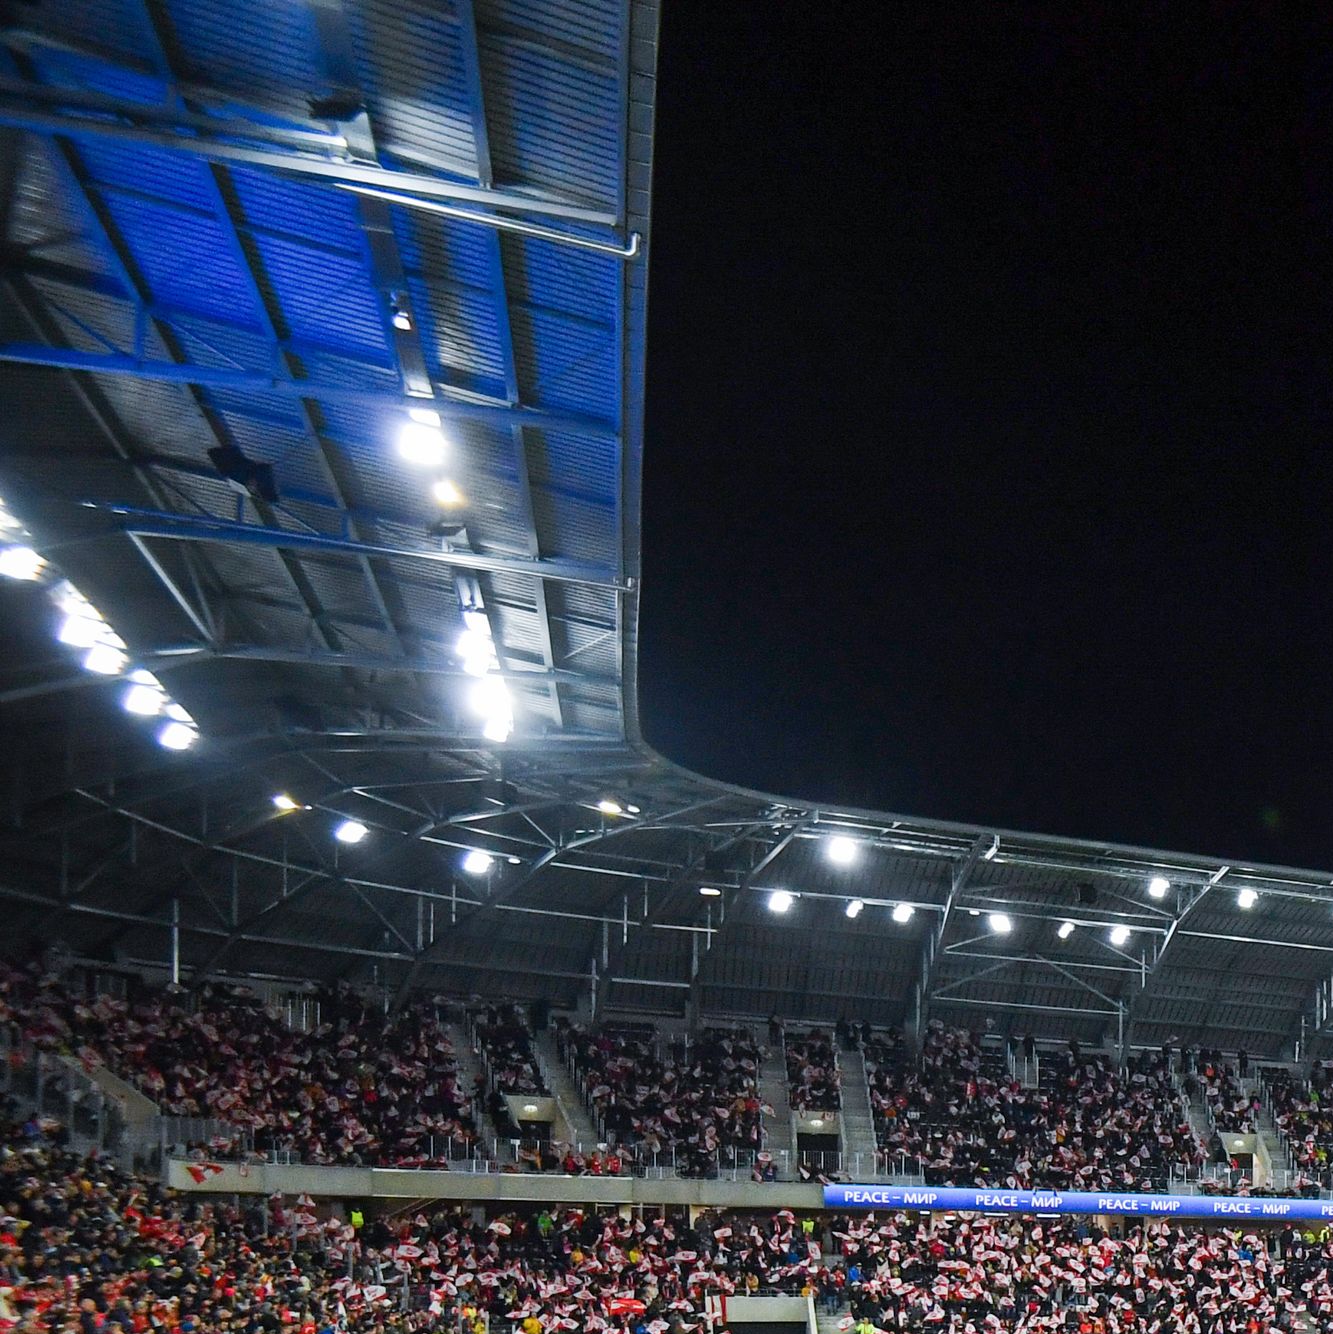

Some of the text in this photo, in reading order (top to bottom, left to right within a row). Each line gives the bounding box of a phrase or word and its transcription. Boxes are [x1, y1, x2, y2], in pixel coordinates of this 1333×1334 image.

[844, 1191, 889, 1203] PEACE
[904, 1192, 937, 1204] МИР
[975, 1195, 1018, 1207] PEACE
[1032, 1197, 1062, 1208] МИР
[1099, 1199, 1137, 1210] PEACE
[1151, 1200, 1180, 1211] МИР
[1214, 1203, 1251, 1213] PEACE
[1263, 1204, 1290, 1214] МИР
